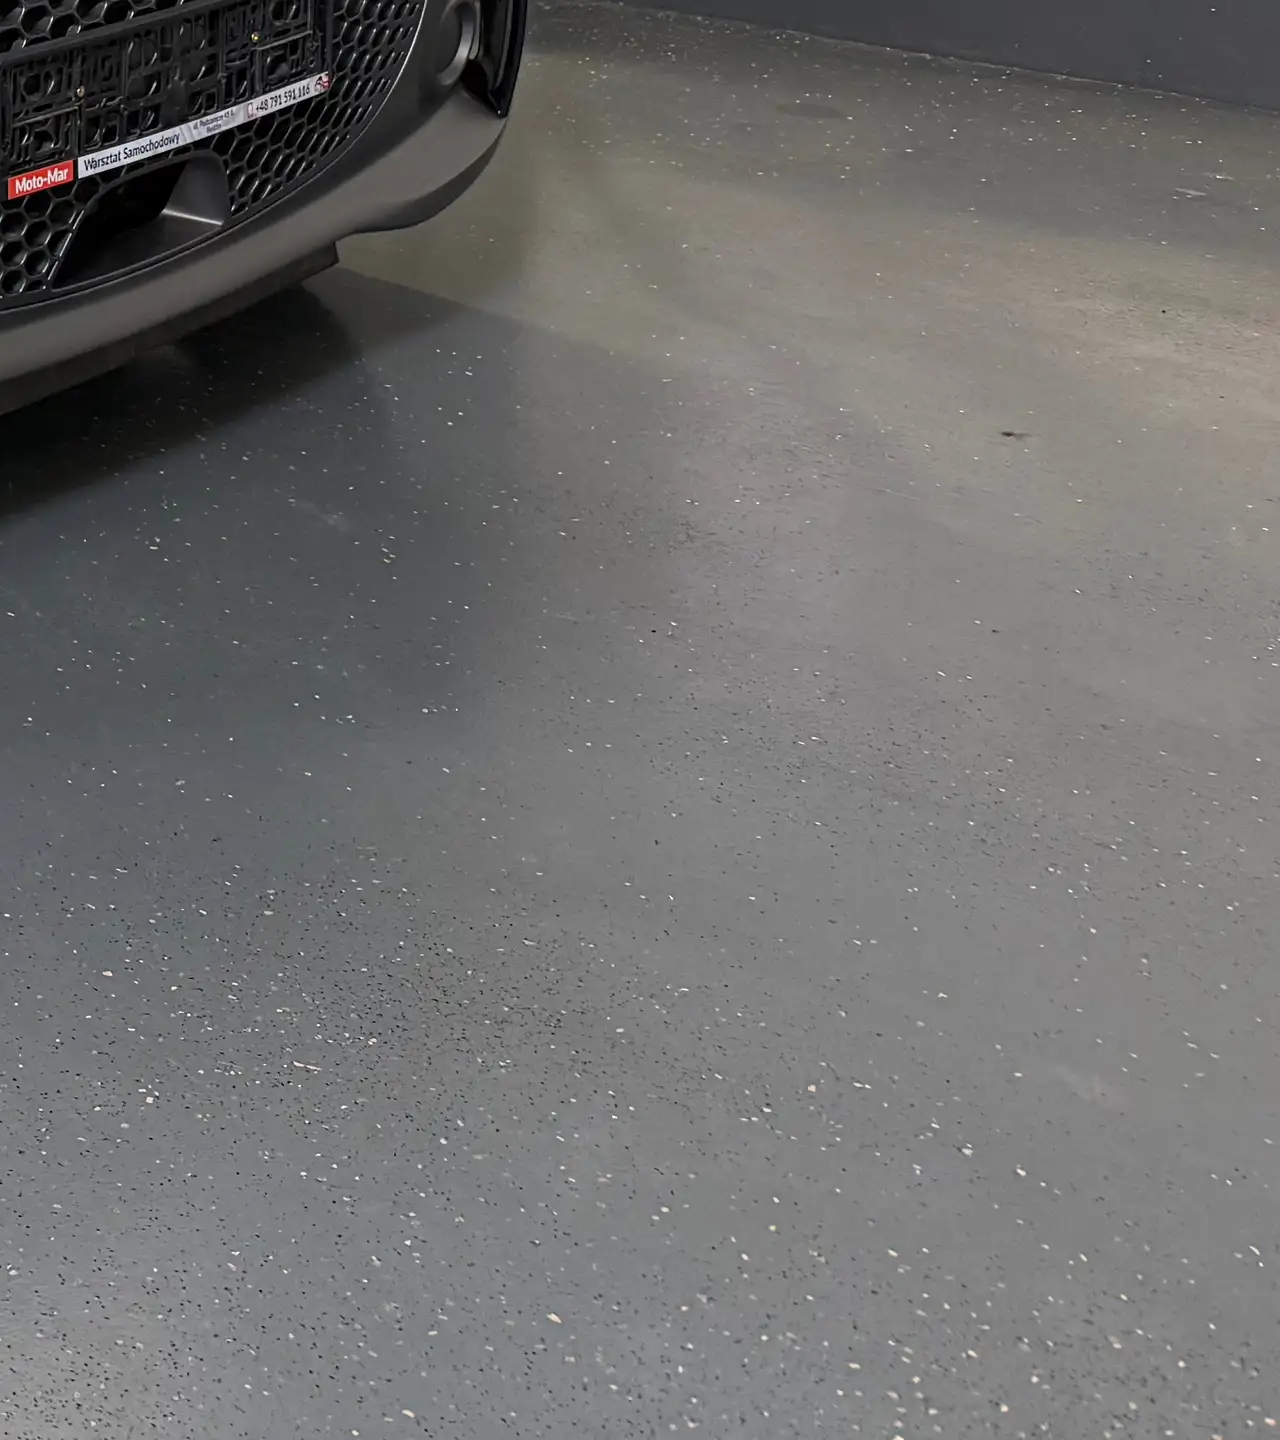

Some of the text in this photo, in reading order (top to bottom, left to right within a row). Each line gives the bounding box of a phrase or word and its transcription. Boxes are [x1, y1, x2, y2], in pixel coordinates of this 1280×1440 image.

[255, 99, 269, 113] +48
[269, 94, 282, 109] 791
[283, 89, 296, 104] 591
[83, 132, 181, 172] Warsztat Samochodowy
[15, 167, 69, 194] Moto-Mar
